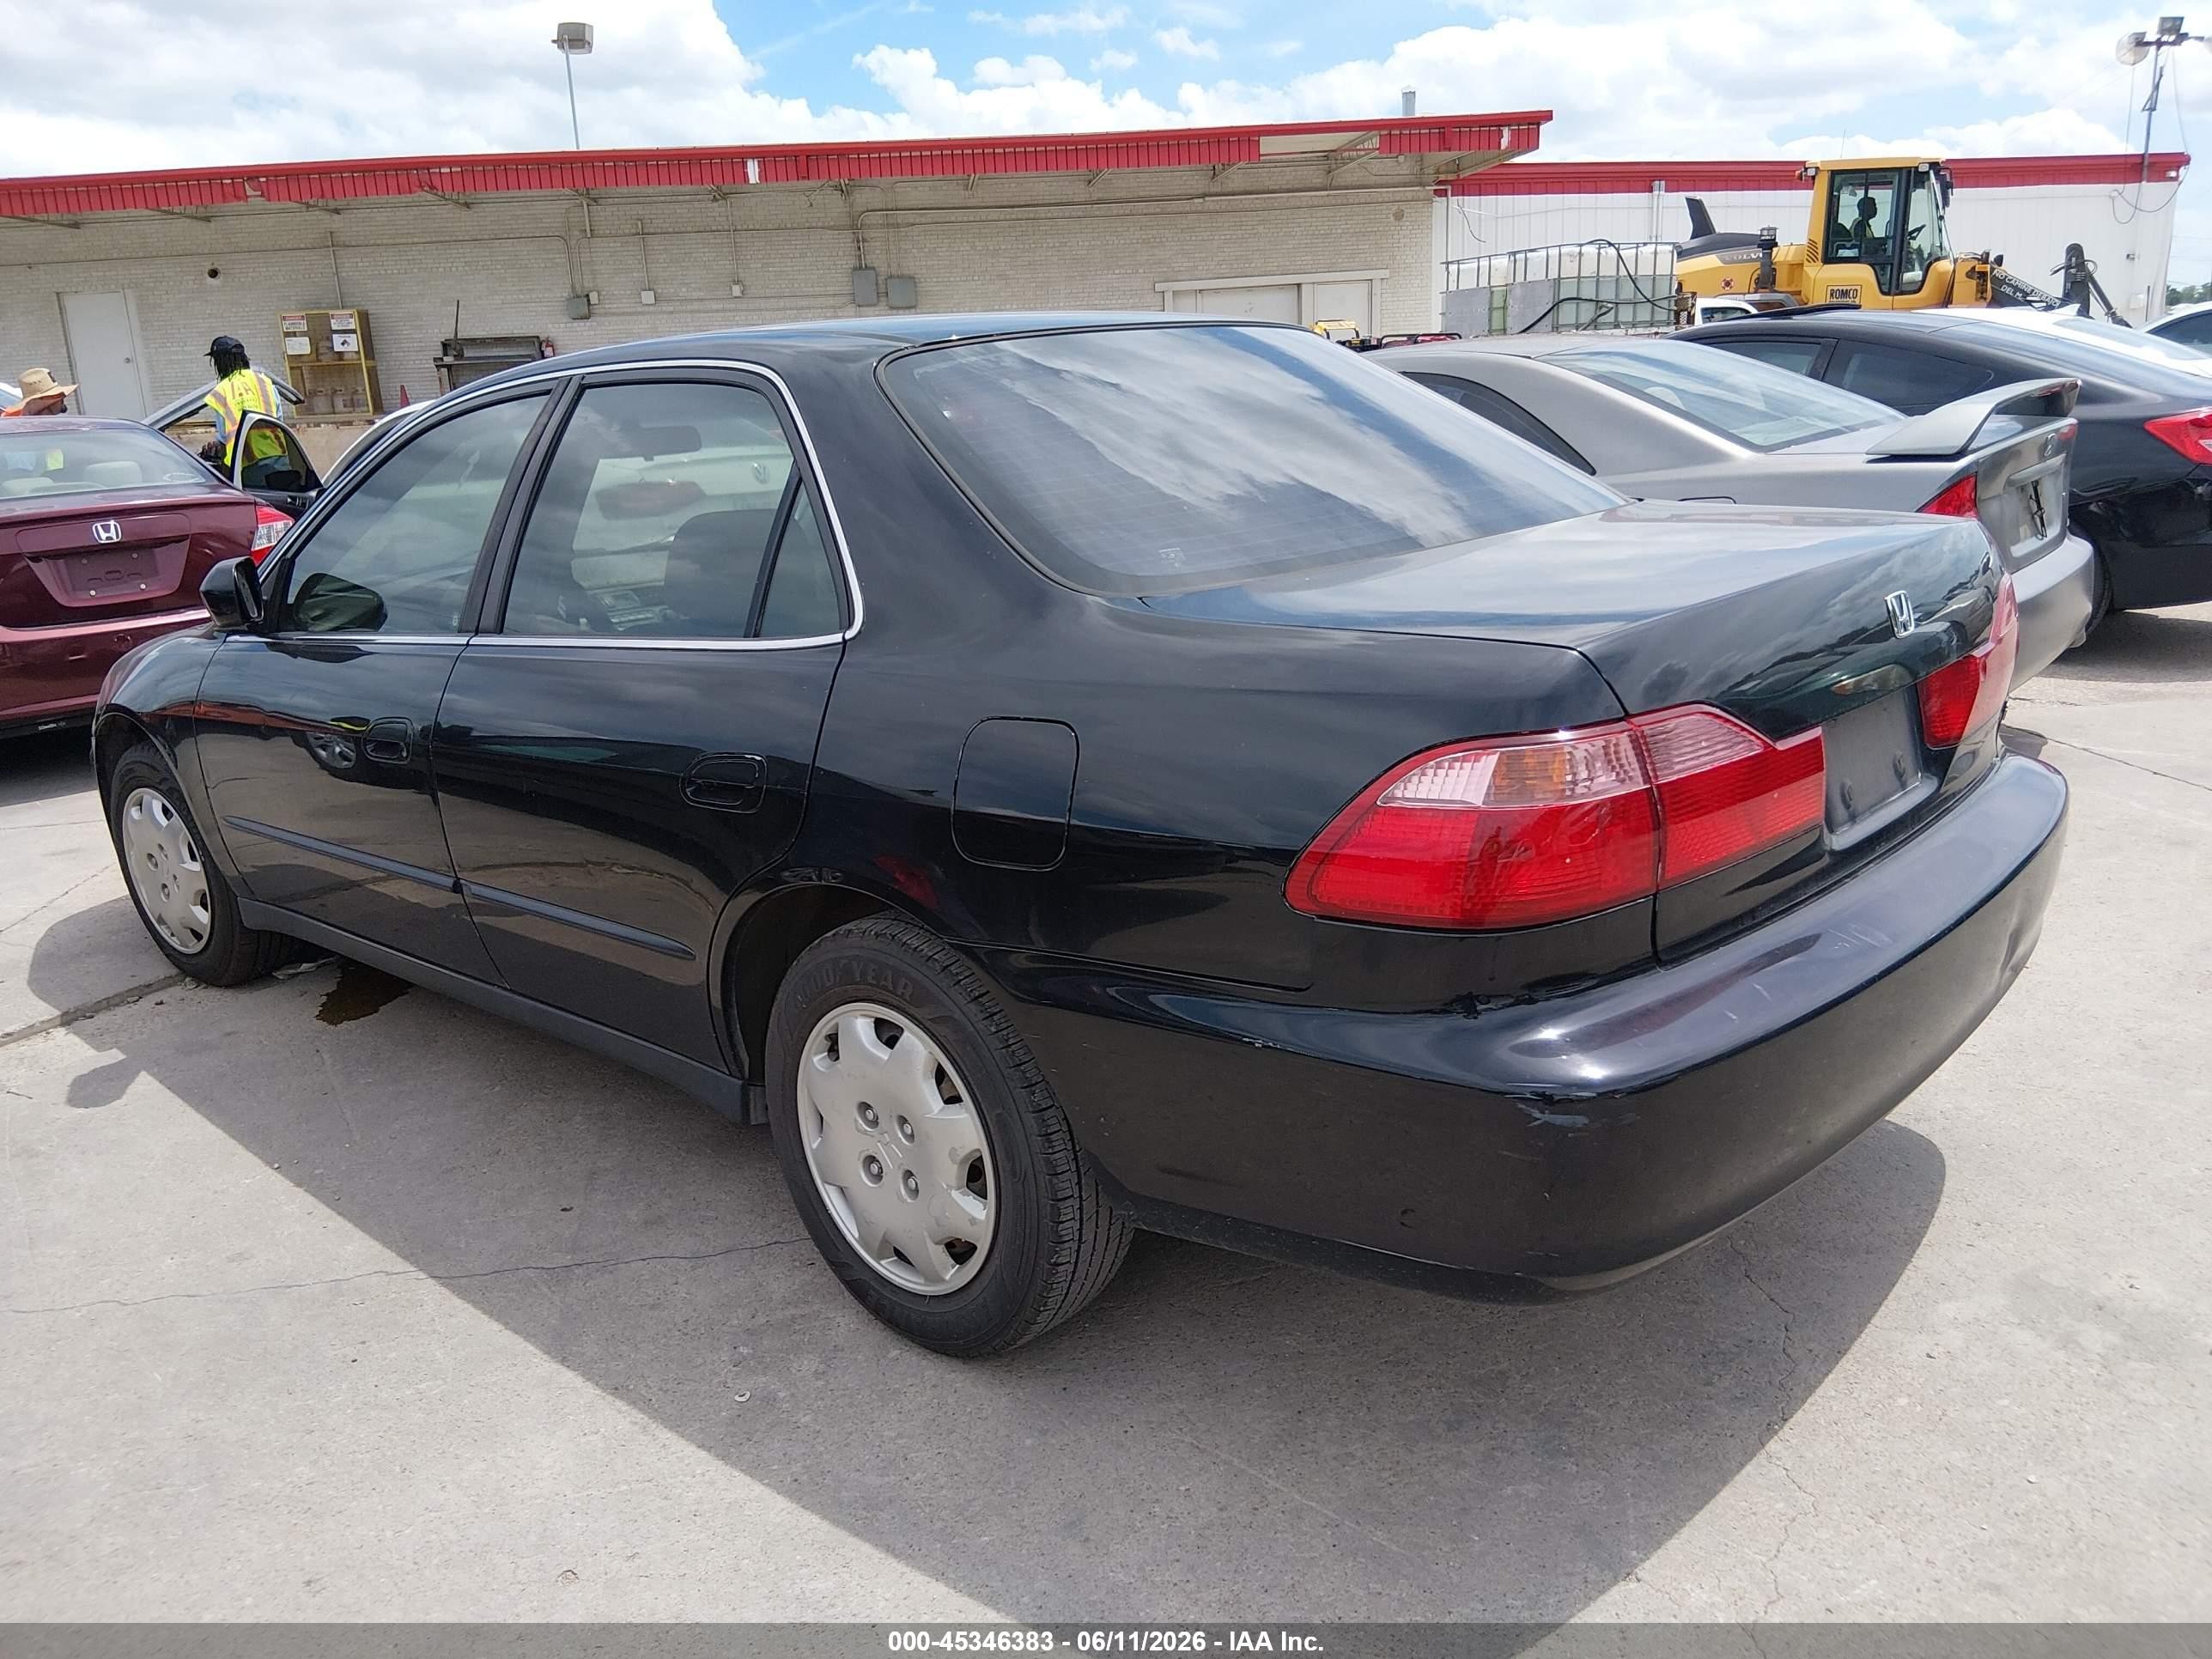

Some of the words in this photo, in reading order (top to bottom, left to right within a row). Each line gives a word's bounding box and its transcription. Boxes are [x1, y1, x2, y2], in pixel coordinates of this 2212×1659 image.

[1992, 269, 2006, 280] NO
[2005, 275, 2033, 294] CAMINE
[1830, 289, 1858, 300] ROMCO
[2001, 284, 2014, 296] DEL
